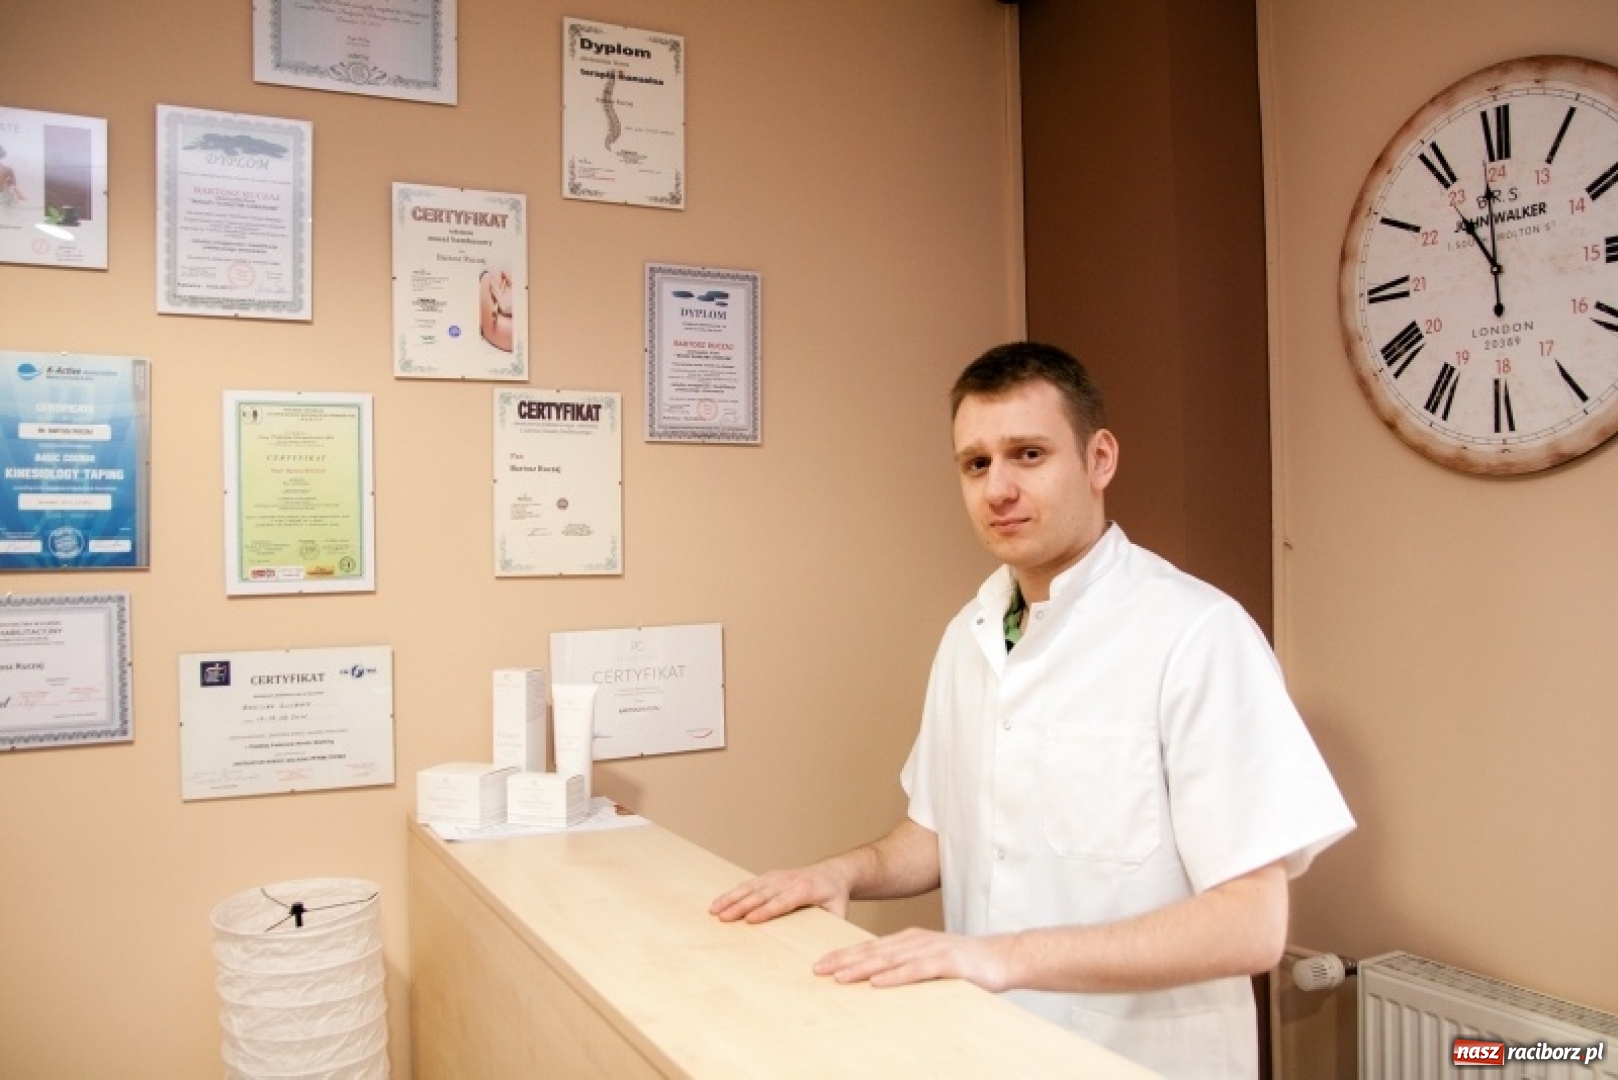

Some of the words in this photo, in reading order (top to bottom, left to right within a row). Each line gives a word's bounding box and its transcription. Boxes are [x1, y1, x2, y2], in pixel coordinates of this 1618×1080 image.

[580, 38, 651, 59] Dyplom
[1488, 164, 1506, 182] 24
[1534, 167, 1550, 185] 13
[1448, 188, 1466, 207] 23
[1493, 201, 1548, 224] WALKER
[1569, 198, 1587, 215] 14
[411, 205, 508, 229] CERTYFIKAT
[1421, 230, 1440, 247] 22
[1582, 244, 1601, 261] 15
[1412, 276, 1427, 292] 21
[680, 307, 727, 320] DYPLOM
[1571, 297, 1588, 314] 16
[1425, 318, 1443, 334] 20
[1471, 321, 1534, 339] LONDON
[1538, 340, 1554, 357] 17
[1455, 350, 1470, 366] 19
[1495, 357, 1511, 374] 18
[517, 400, 602, 422] CERTYFIKAT
[4, 466, 80, 480] KINESIOLOGY
[83, 468, 125, 480] TAPING
[250, 672, 326, 686] CERTYFIKAT
[592, 664, 687, 685] CERTYFIKAT
